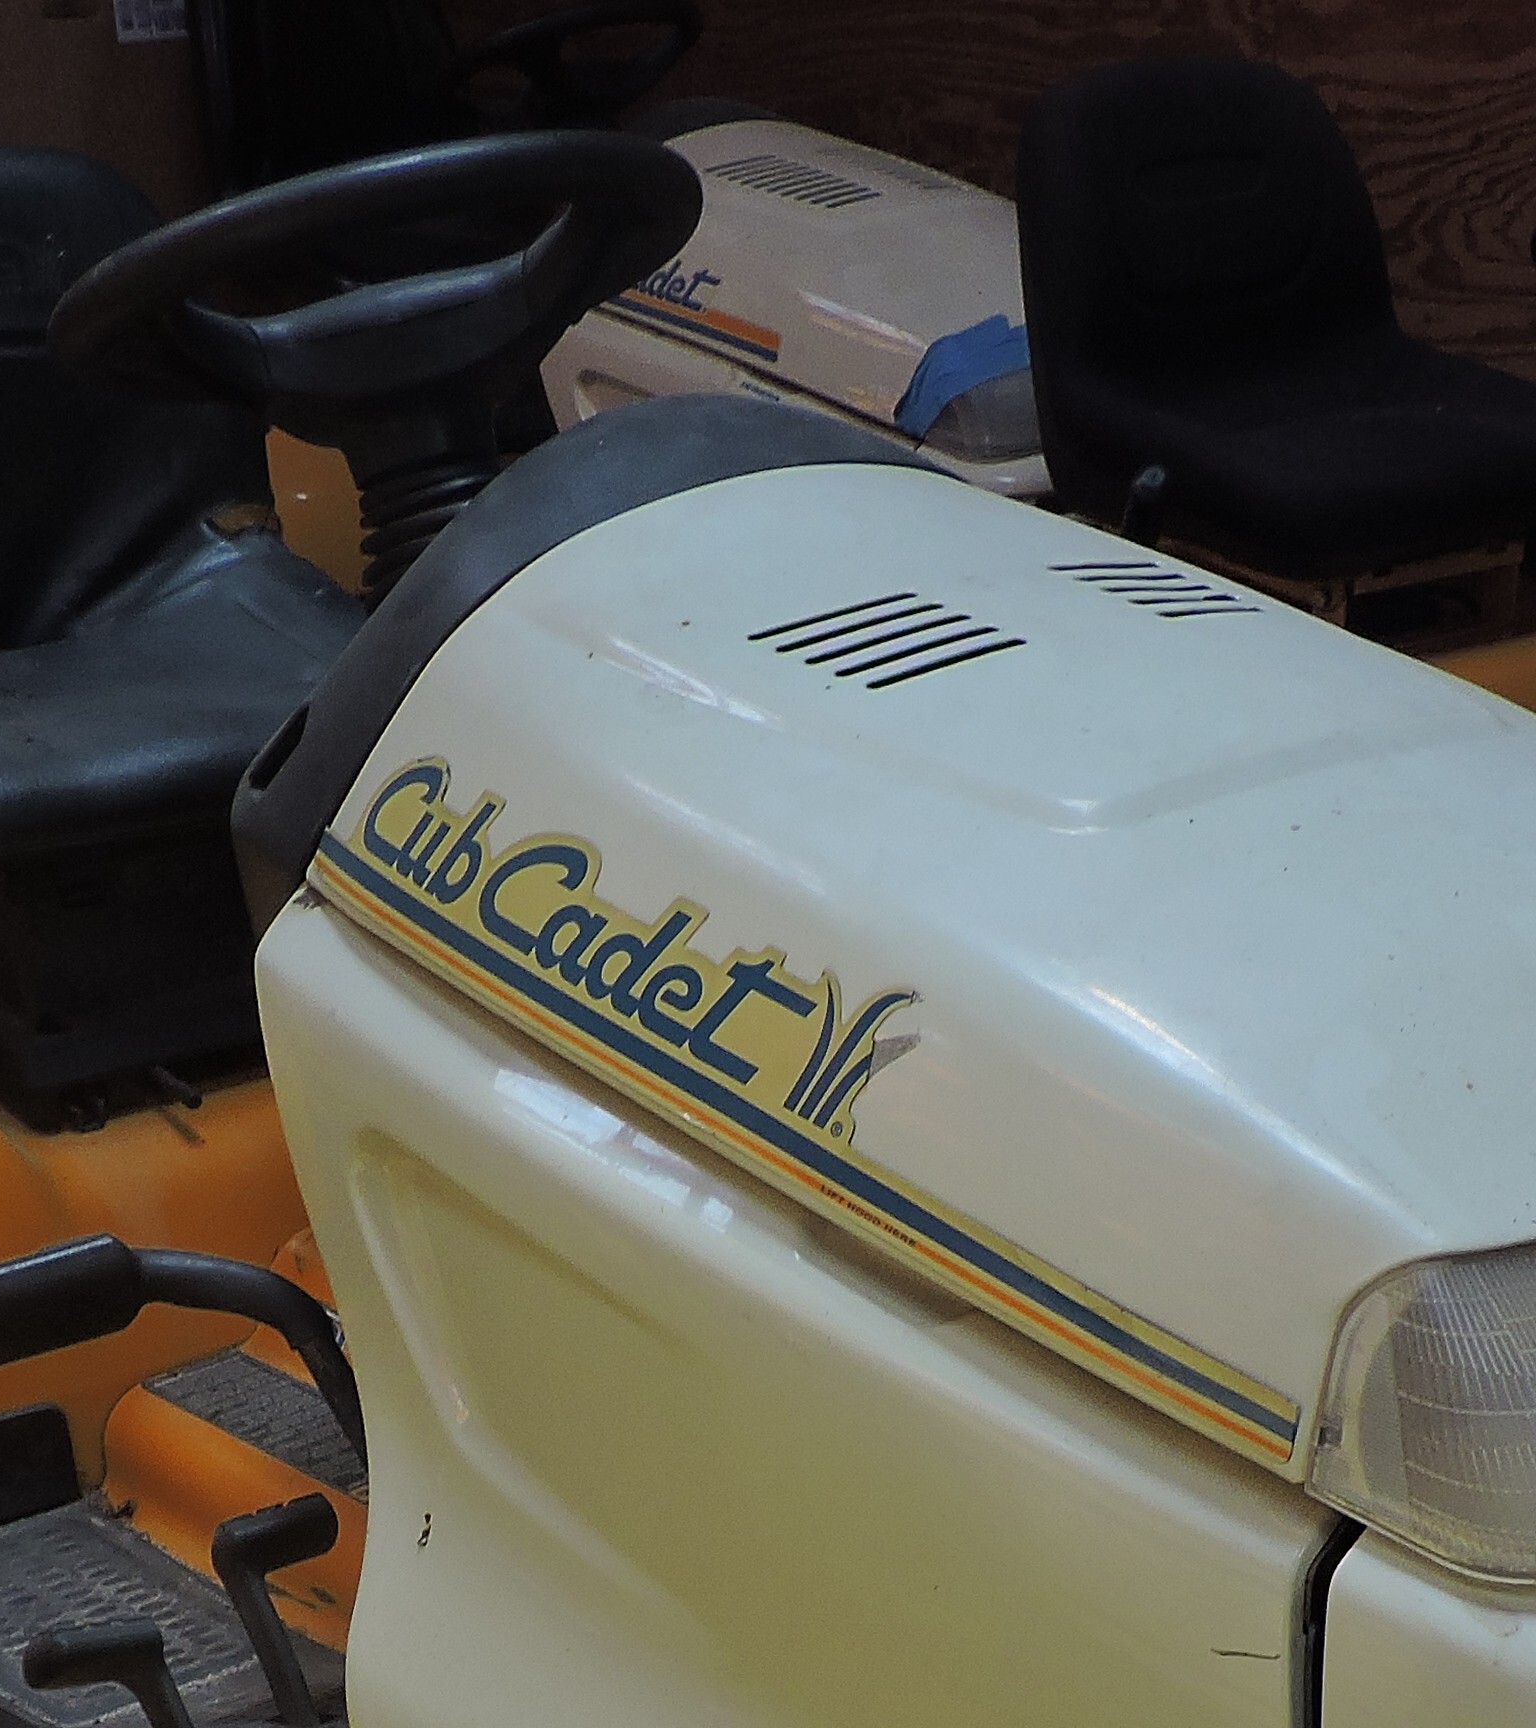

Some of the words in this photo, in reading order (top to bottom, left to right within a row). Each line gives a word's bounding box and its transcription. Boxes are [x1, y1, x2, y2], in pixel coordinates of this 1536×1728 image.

[637, 259, 721, 311] det
[363, 765, 497, 905] Cub
[478, 844, 818, 1086] Cadet
